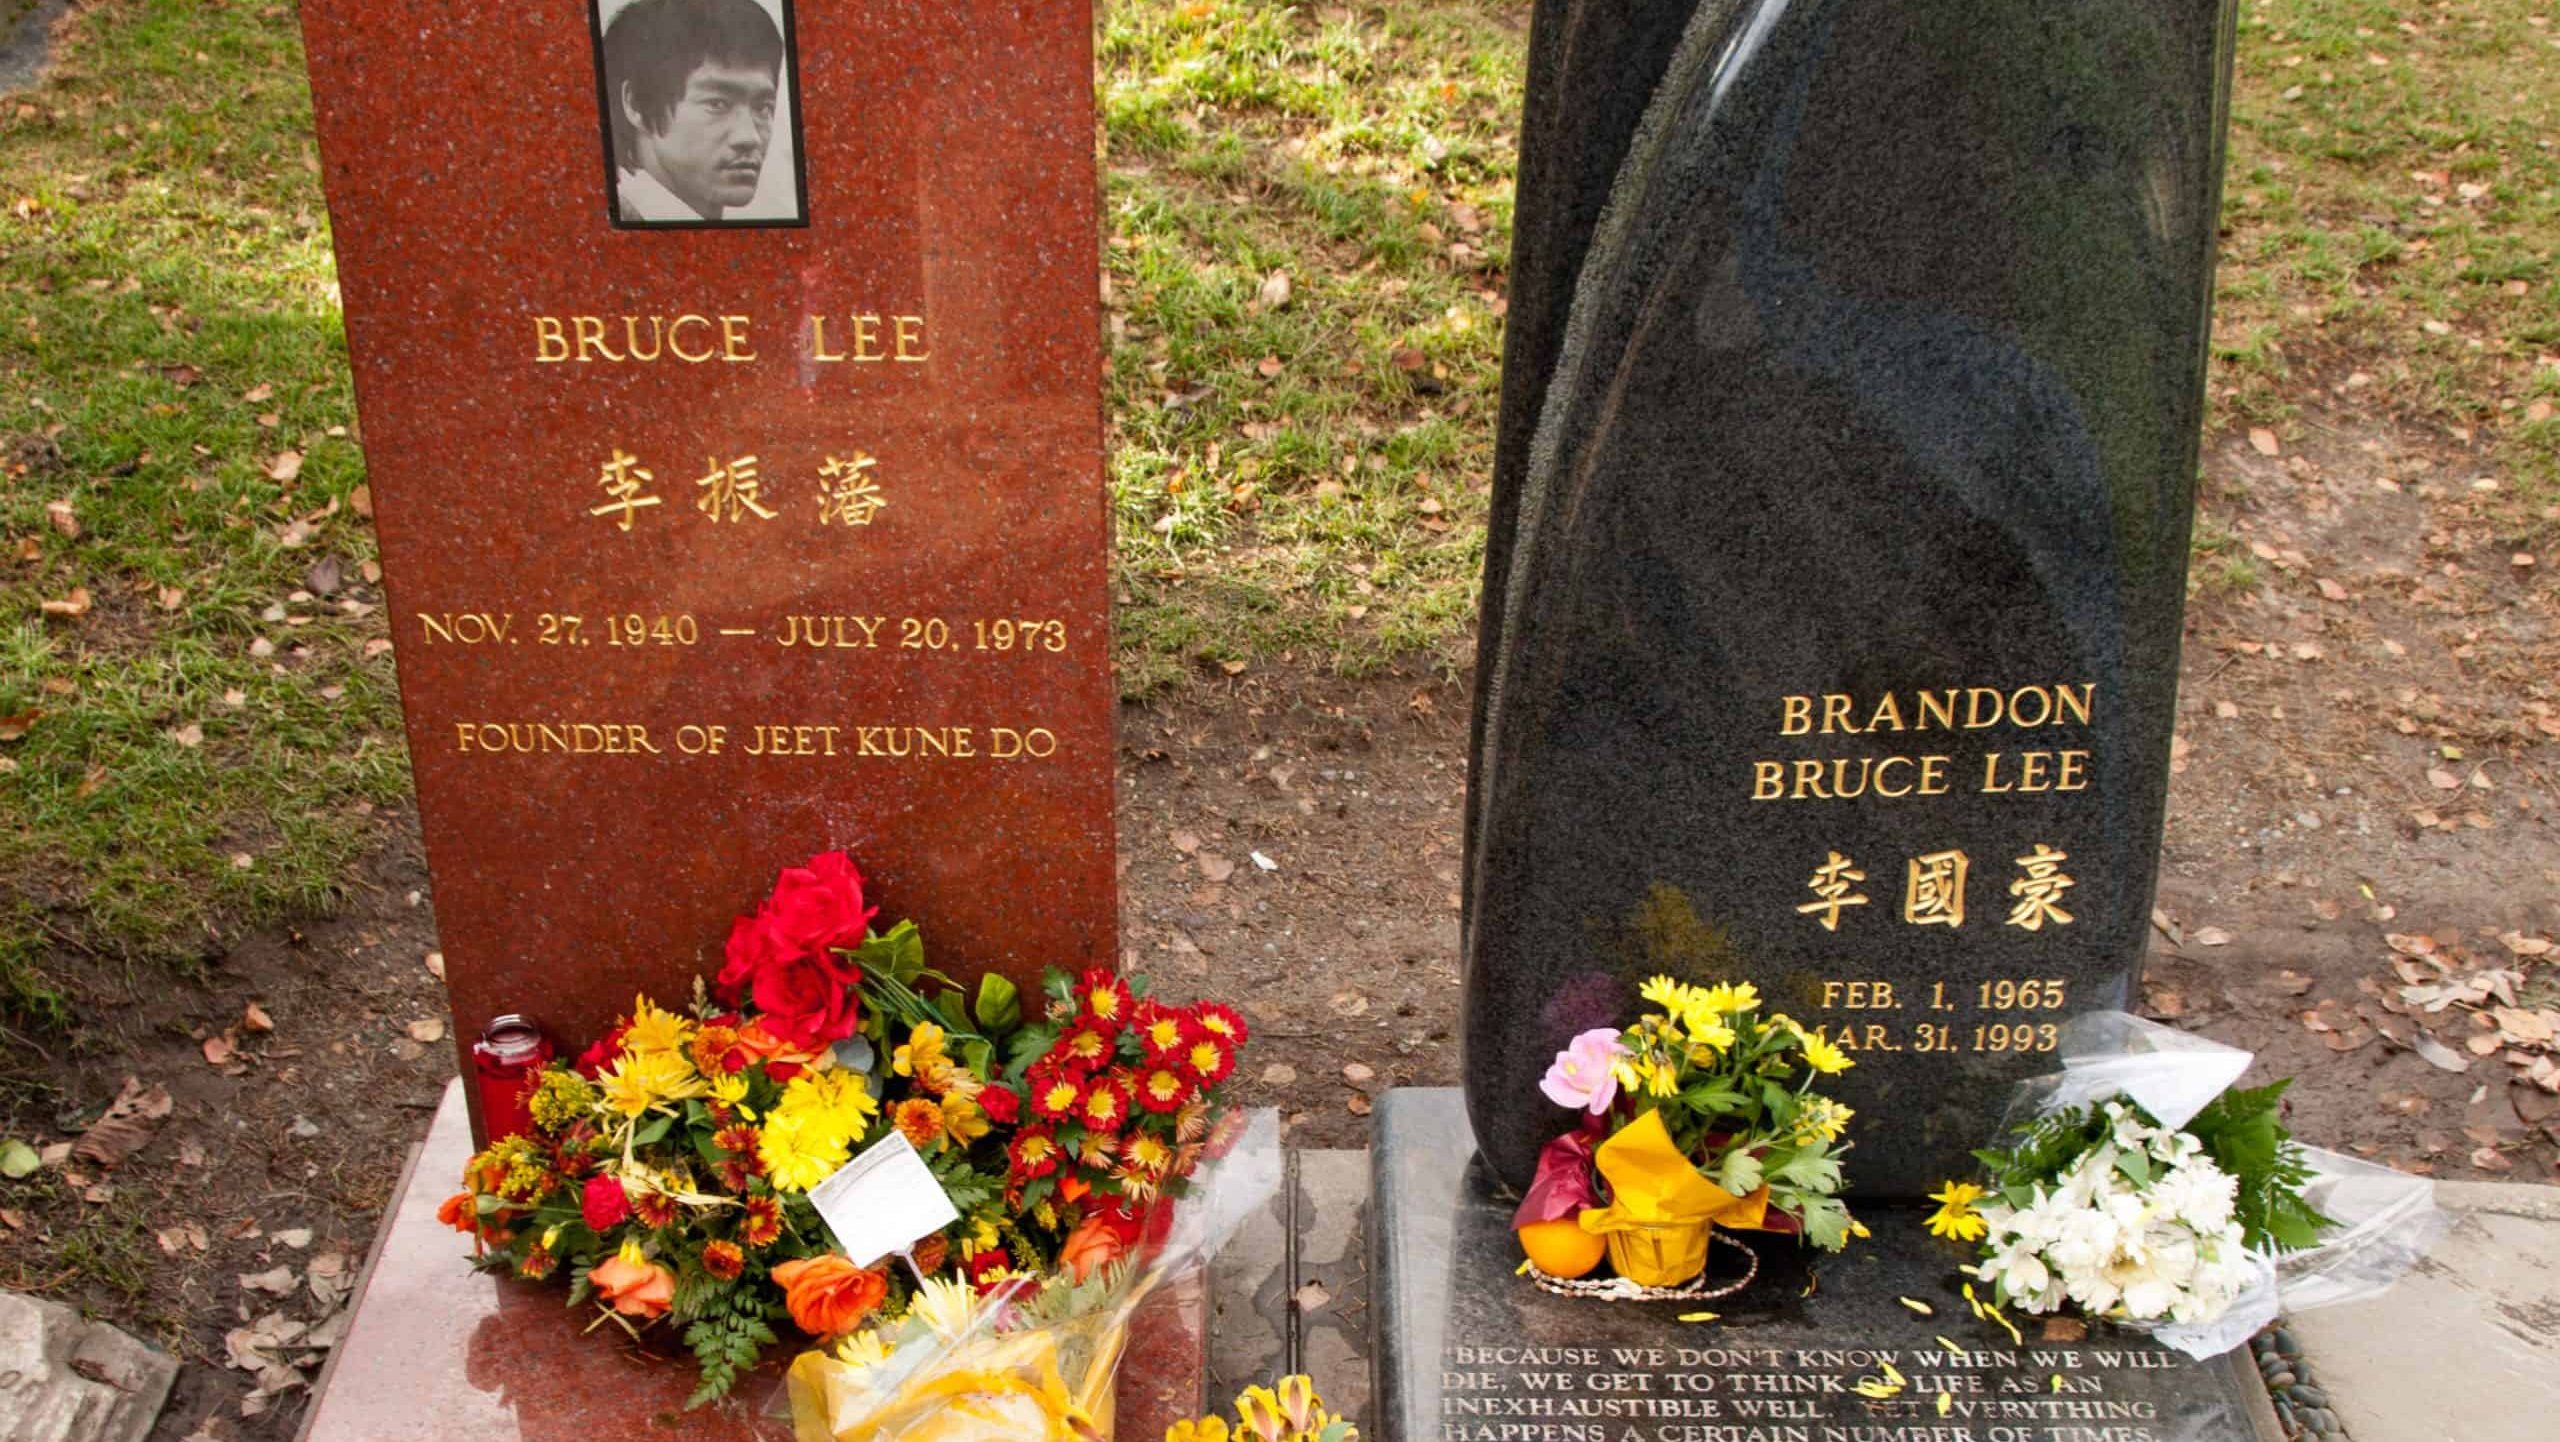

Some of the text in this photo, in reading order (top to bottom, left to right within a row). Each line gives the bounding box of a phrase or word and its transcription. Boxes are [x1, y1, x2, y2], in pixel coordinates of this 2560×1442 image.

[535, 314, 931, 363] BRUCE LEE
[589, 447, 890, 533] 李振藩
[417, 612, 518, 646] NOV.
[607, 613, 698, 646] 1940
[776, 615, 886, 648] JULY
[973, 618, 1067, 653] 1973
[1779, 682, 2098, 736] BRANDON
[455, 722, 1057, 758] FOUNDER OF JEET KUNE DO
[1751, 750, 2091, 800] BRUCE LEE
[1795, 842, 2077, 932] 李國豪
[1821, 981, 1904, 1010] FEB.
[1977, 979, 2066, 1010] 1965
[1972, 1023, 2058, 1052] 1993
[1612, 1349, 1665, 1366] WE
[1677, 1349, 1783, 1367] DON'T
[1797, 1350, 1900, 1367] KNOW
[1912, 1350, 2018, 1368] WHEN
[2030, 1351, 2082, 1369] WE
[2096, 1351, 2177, 1369] WILL
[1441, 1372, 1508, 1392] DIE,
[1519, 1372, 1575, 1391] WE
[1586, 1373, 1653, 1392] GET
[1665, 1374, 1715, 1392] TO
[1726, 1374, 1846, 1393] THINK
[1912, 1375, 1985, 1393] LIFE
[2000, 1375, 2039, 1393] AS
[1442, 1398, 1721, 1418] INEXHAUSTIBLE
[1731, 1400, 1834, 1418] WELL.
[1442, 1423, 1604, 1442] HAPPENS
[1620, 1425, 1646, 1442] A
[1657, 1425, 1809, 1442] CERTAIN
[1823, 1427, 1975, 1442] NUMBER
[1988, 1427, 2033, 1442] OF
